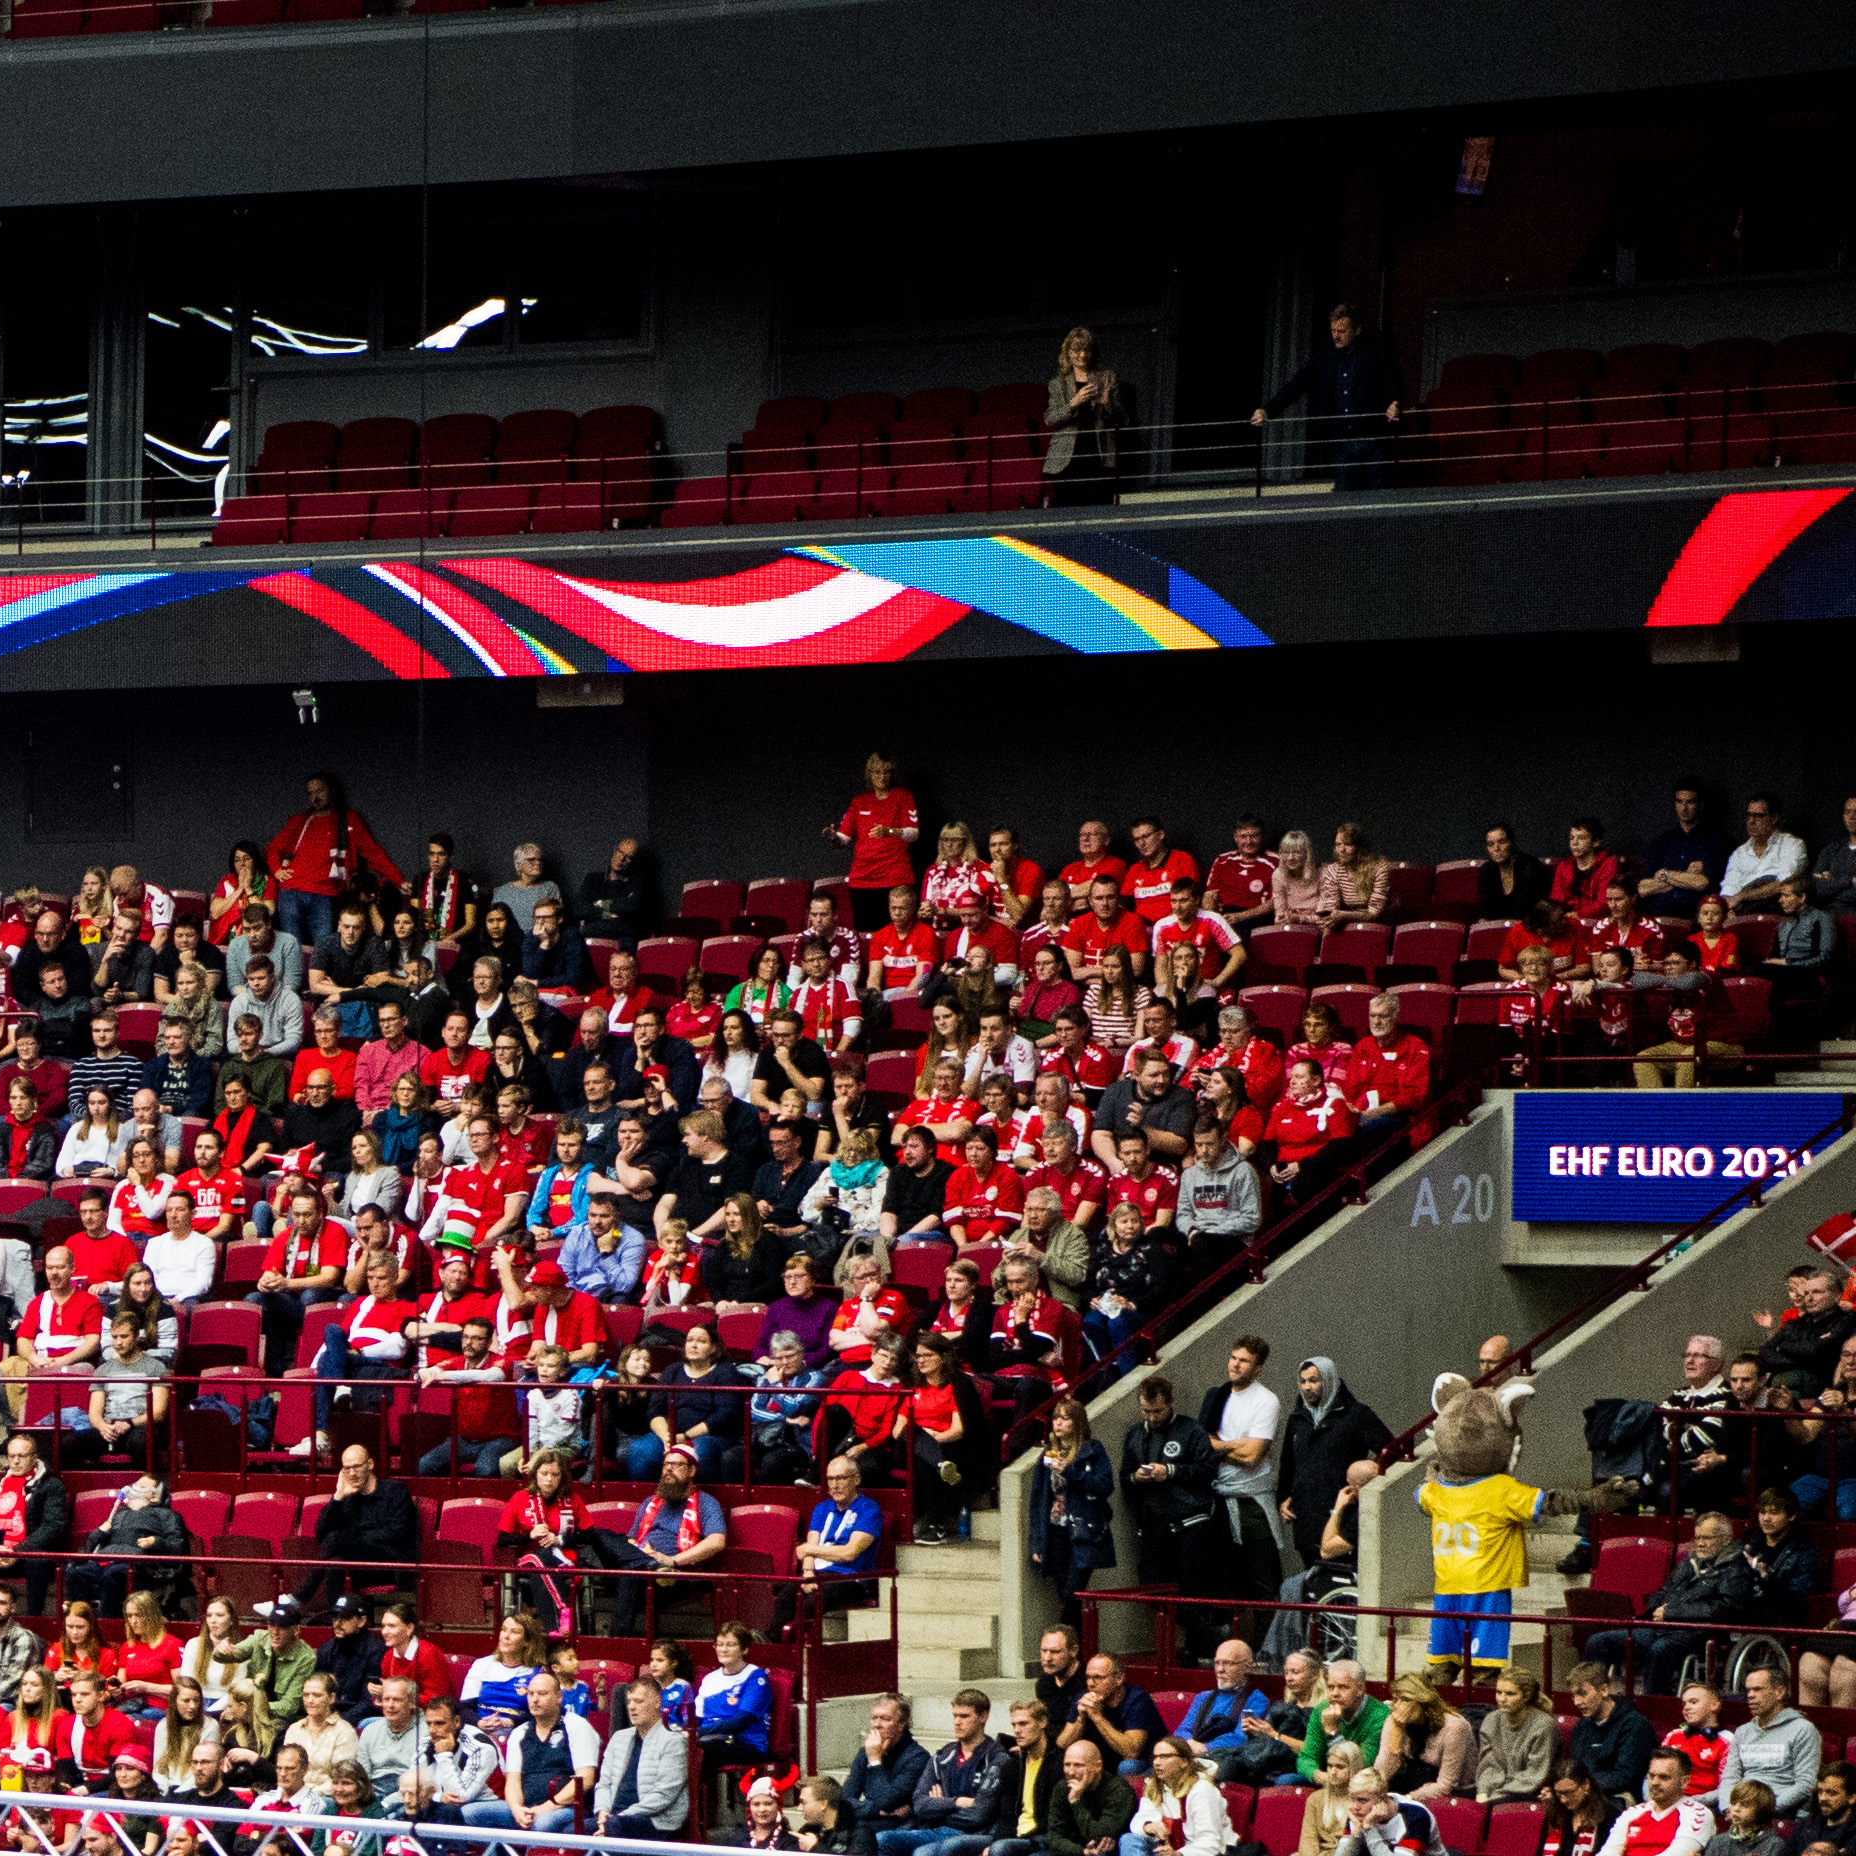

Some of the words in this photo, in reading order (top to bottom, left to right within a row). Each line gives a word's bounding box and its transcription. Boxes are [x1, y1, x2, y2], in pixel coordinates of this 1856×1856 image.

[1549, 1146, 1610, 1176] EHF
[1617, 1146, 1714, 1177] EURO
[1410, 1178, 1441, 1227] A
[1453, 1173, 1495, 1225] 20
[1432, 1522, 1480, 1558] 20
